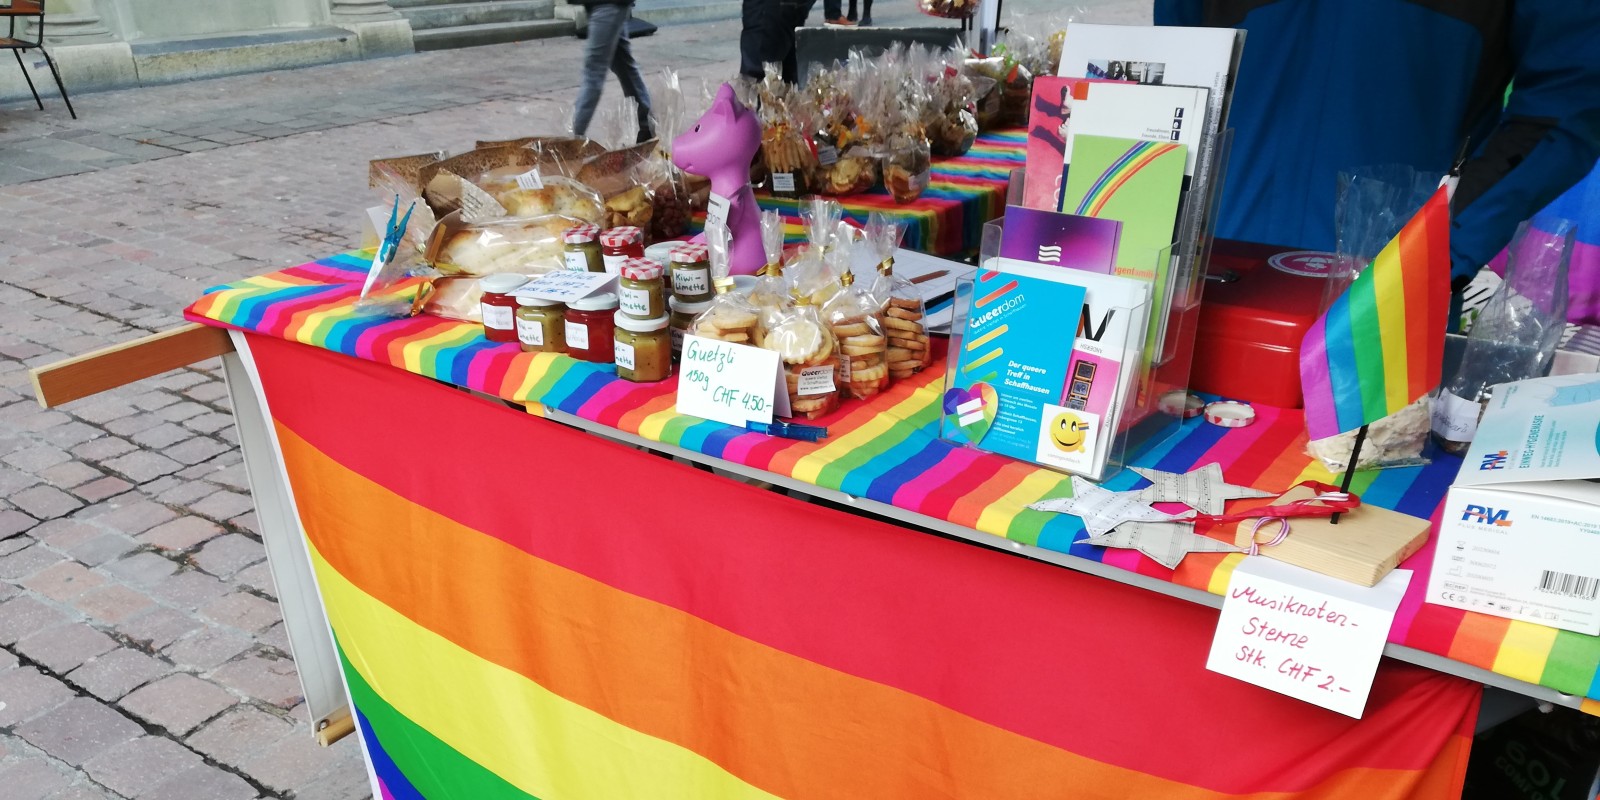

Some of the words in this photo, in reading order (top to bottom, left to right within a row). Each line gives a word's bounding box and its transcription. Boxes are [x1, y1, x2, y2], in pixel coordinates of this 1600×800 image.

[675, 283, 706, 291] Limette
[970, 294, 1025, 328] Queerdom
[687, 340, 737, 373] Guetzli
[1008, 360, 1021, 369] Der
[1022, 363, 1047, 375] queere
[686, 370, 709, 391] 150g
[1004, 378, 1050, 395] Schaffhausen
[1006, 369, 1024, 378] Treff
[1023, 373, 1031, 381] in
[713, 385, 740, 408] CHF
[1232, 586, 1358, 627] Musiknoten-
[1242, 617, 1309, 649] Sterne
[1236, 646, 1267, 668] Stk.
[1278, 658, 1321, 683] CHF
[1318, 675, 1351, 693] 2.-
